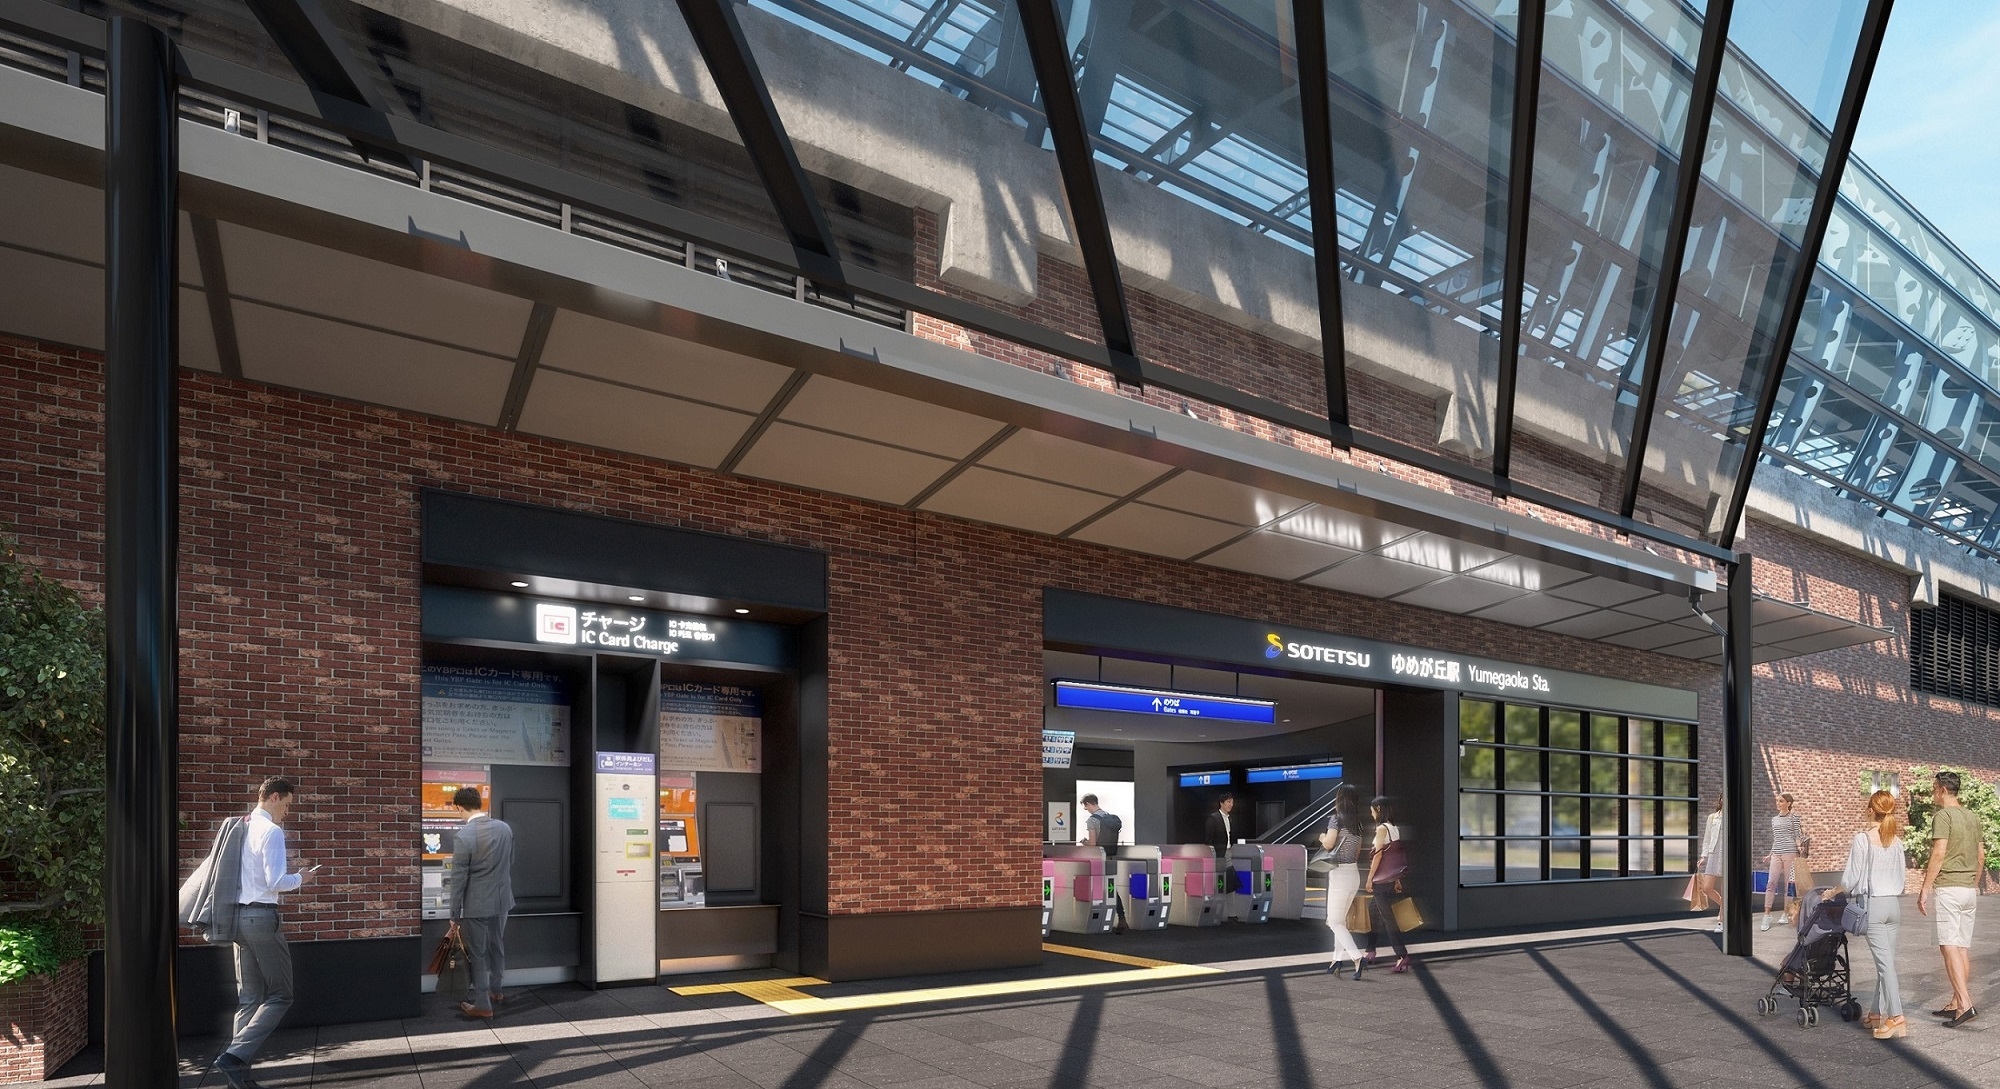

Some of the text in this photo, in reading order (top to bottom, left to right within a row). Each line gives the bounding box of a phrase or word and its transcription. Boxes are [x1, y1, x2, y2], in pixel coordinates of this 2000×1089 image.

[581, 612, 646, 632] チャージ
[581, 630, 679, 654] IC Card Charge
[1287, 642, 1370, 668] SOTETSU
[1391, 653, 1460, 682] ゆめが丘駅
[1468, 664, 1550, 692] Yumegaoka Sta.
[1164, 698, 1180, 706] のりば
